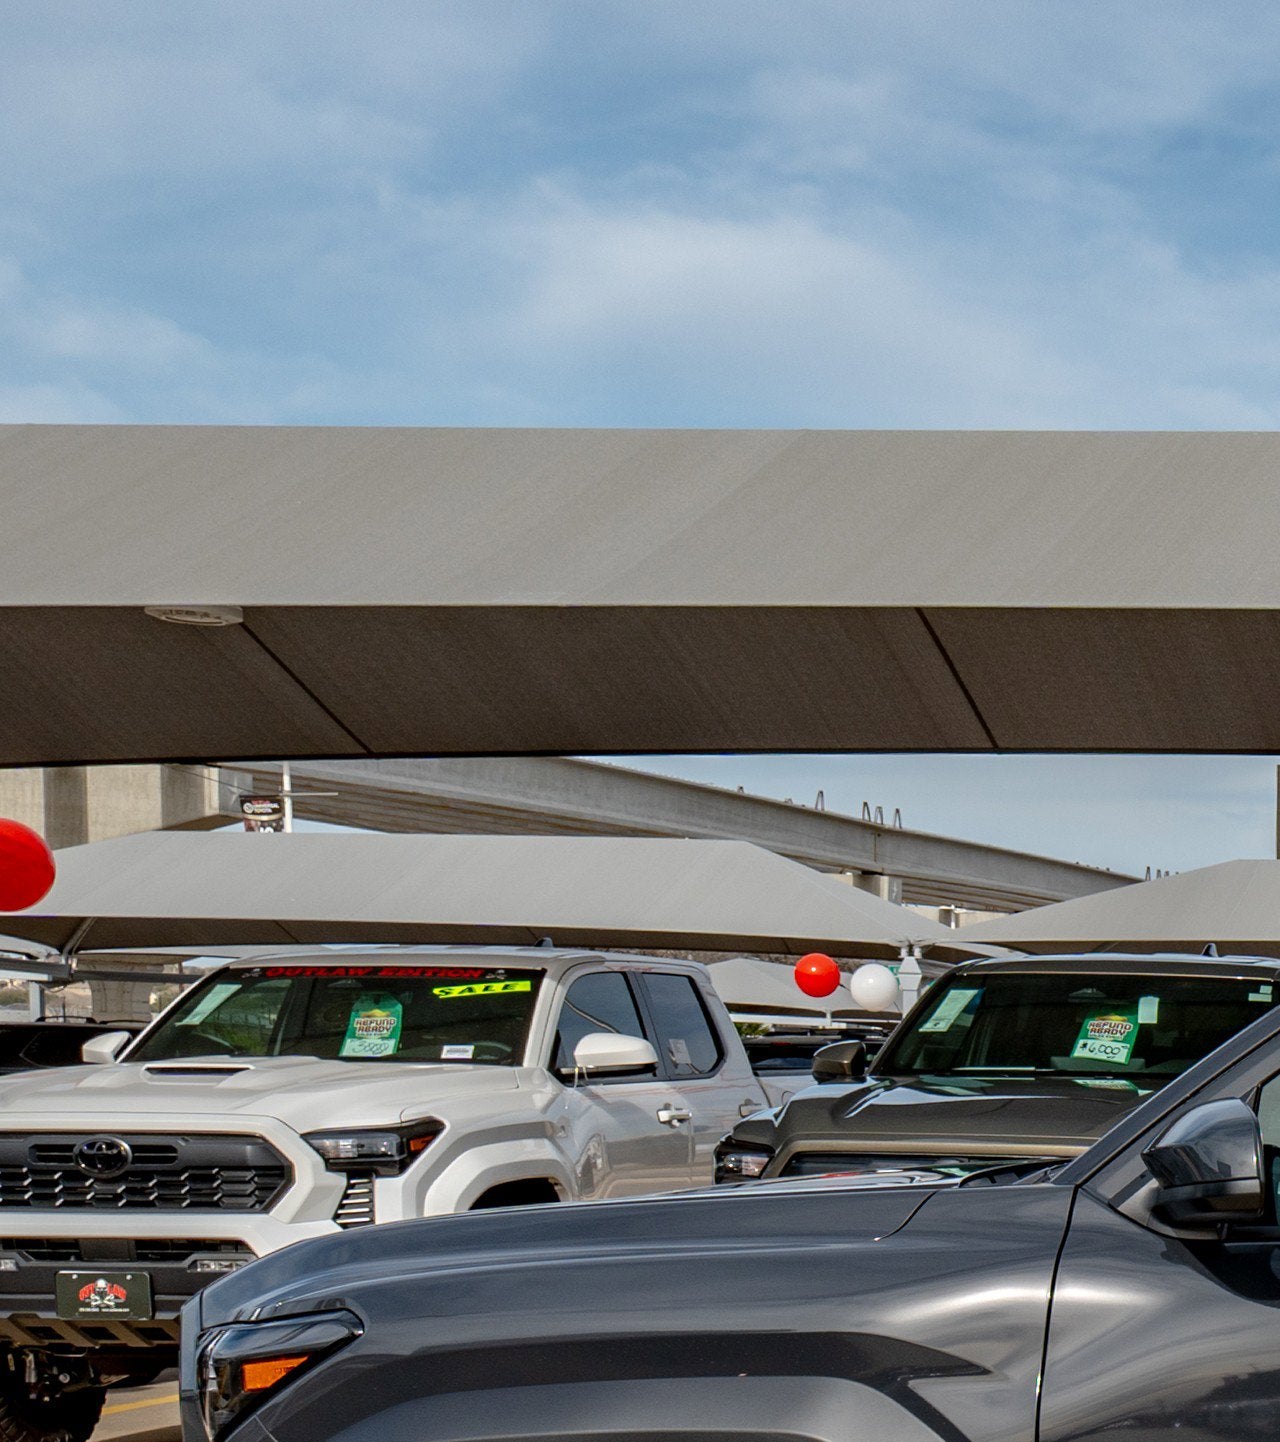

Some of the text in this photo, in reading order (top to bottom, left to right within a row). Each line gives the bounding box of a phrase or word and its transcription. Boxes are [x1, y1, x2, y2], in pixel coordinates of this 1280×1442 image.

[266, 966, 485, 979] OUTLAW EDITION
[437, 981, 521, 997] SALE
[1089, 1021, 1132, 1031] REFUND
[1090, 1027, 1126, 1036] READY
